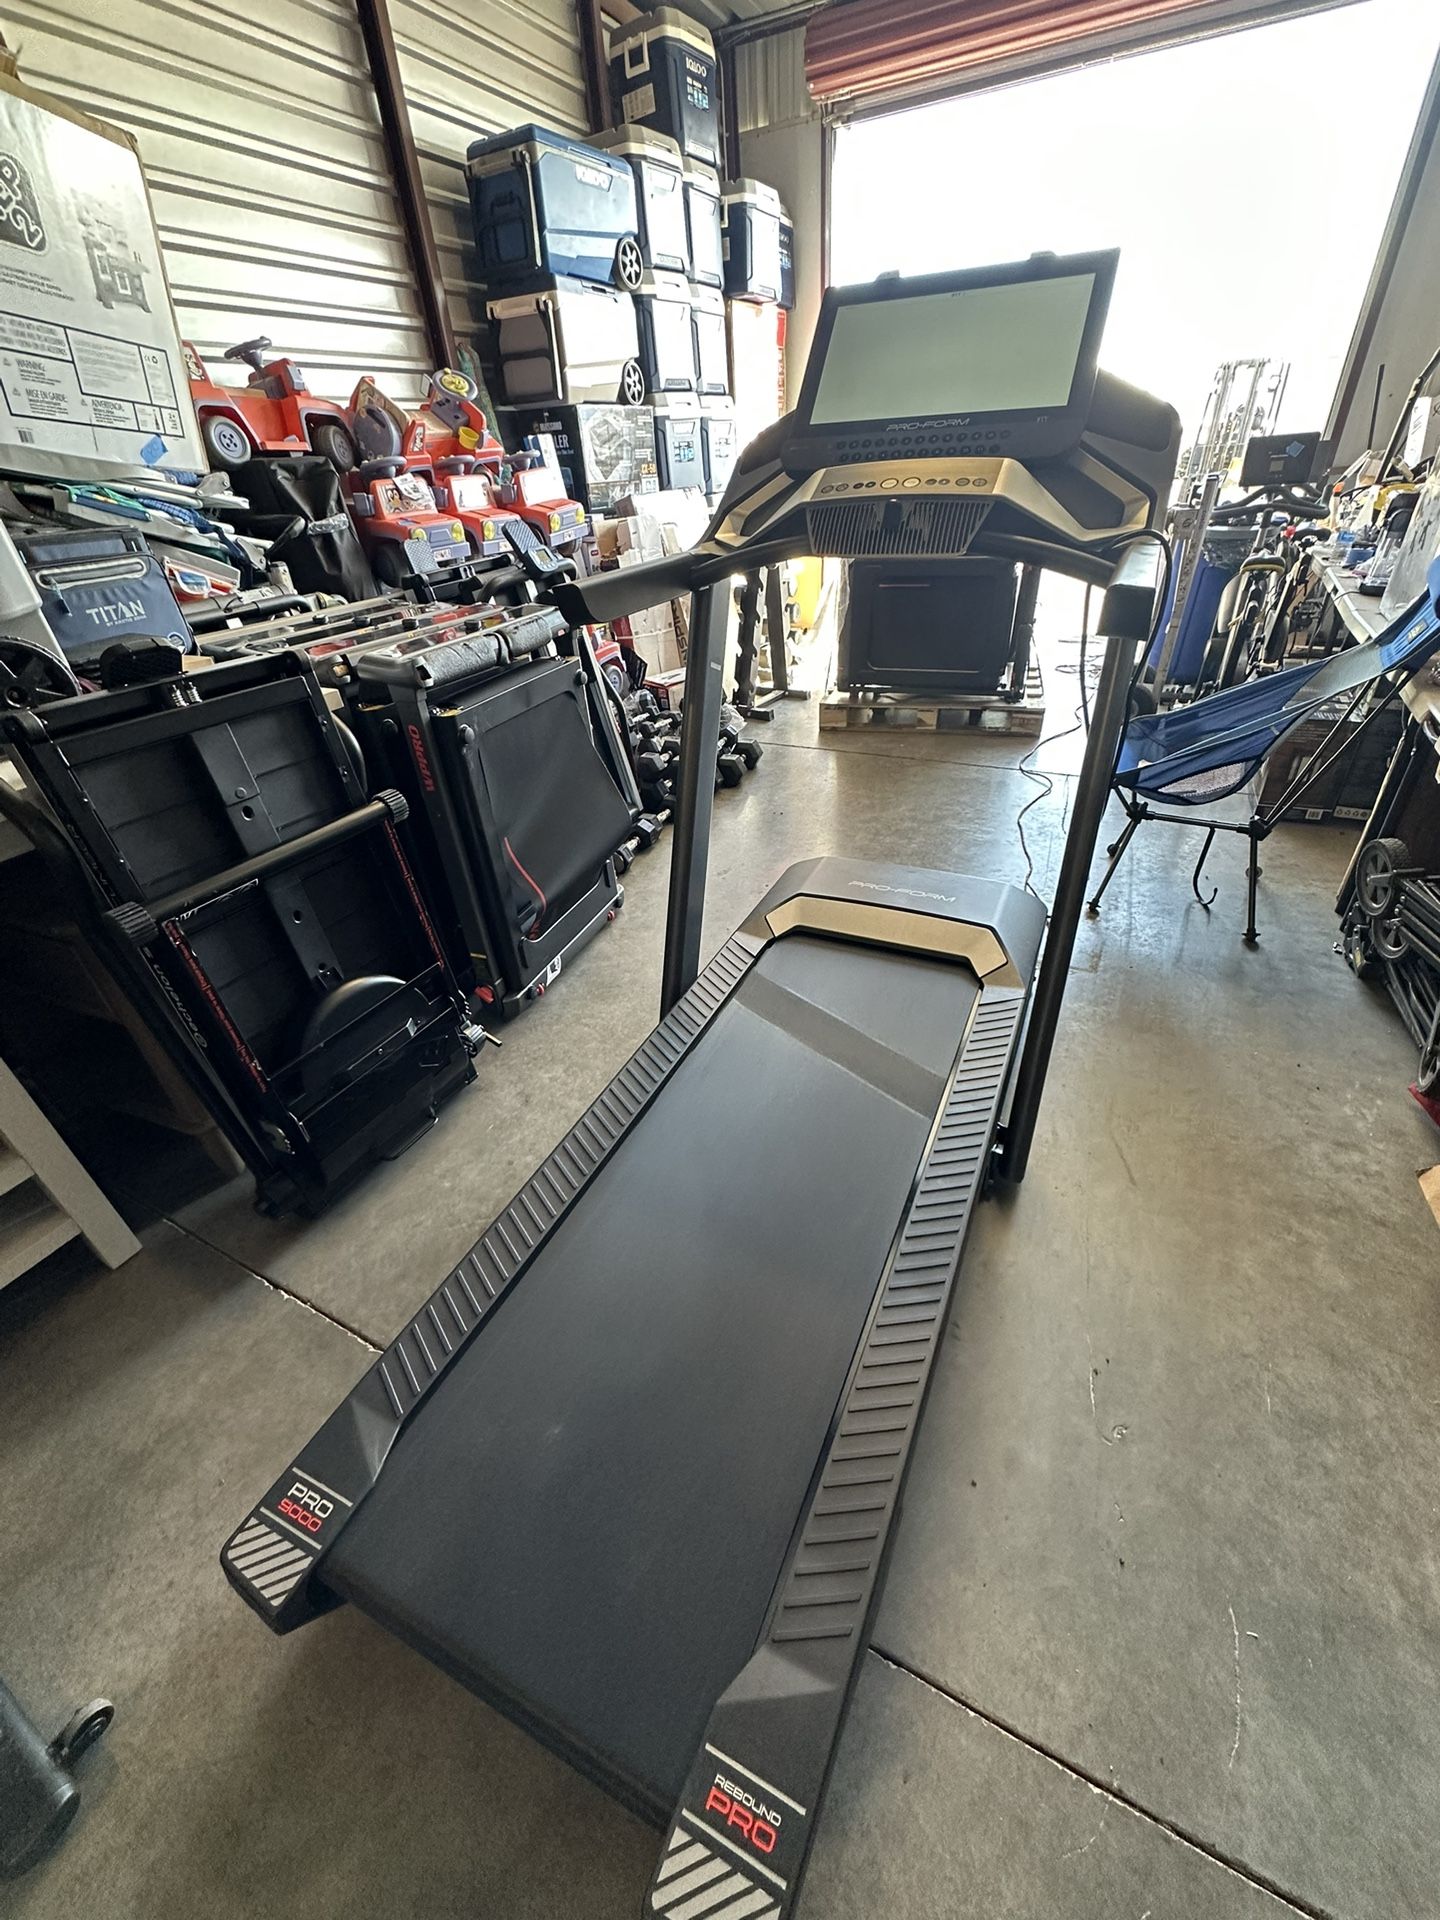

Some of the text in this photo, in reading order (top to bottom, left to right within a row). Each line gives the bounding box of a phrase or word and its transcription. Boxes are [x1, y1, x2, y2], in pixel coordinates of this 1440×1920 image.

[85, 599, 146, 625] TITAN
[848, 880, 957, 903] PRO-FORM
[277, 1497, 323, 1533] 9000
[287, 1481, 334, 1519] PRO
[713, 1773, 782, 1827] REBOUND
[704, 1785, 779, 1854] PRO
